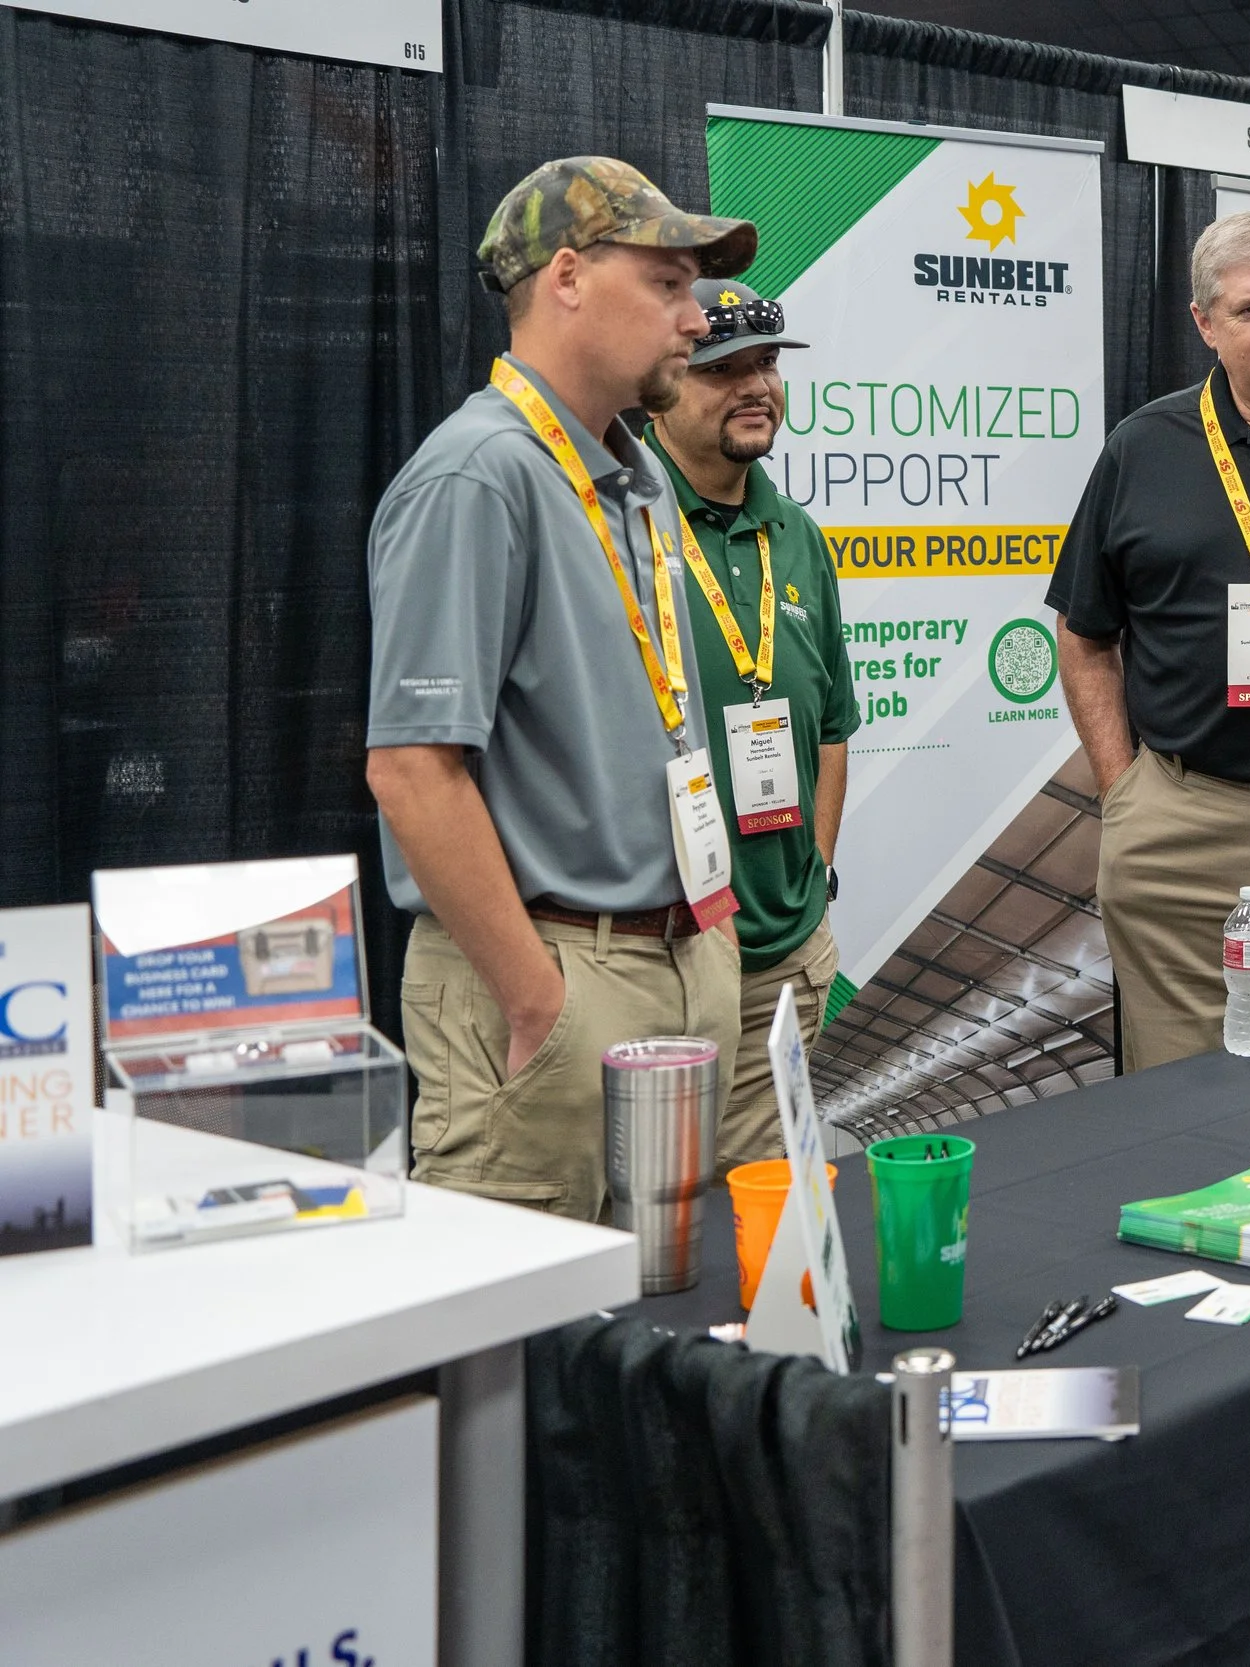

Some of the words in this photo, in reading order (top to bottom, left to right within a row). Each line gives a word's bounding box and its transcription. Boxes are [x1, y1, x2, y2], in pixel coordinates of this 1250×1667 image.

[404, 42, 426, 61] 615
[914, 253, 1069, 293] SUNBELT
[937, 289, 1047, 307] RENTALS
[784, 380, 1080, 439] USTOMIZED
[1219, 458, 1231, 473] 3S
[768, 452, 1000, 507] UPPORT
[1233, 498, 1247, 514] 3S
[829, 536, 917, 568] YOUR
[926, 534, 1060, 567] PROJECT
[842, 618, 969, 648] emporary
[853, 659, 897, 681] res
[903, 652, 942, 679] for
[866, 691, 908, 725] job
[988, 709, 1025, 723] LEARN
[1028, 708, 1059, 721] MORE
[750, 736, 773, 747] Miguel
[747, 812, 793, 828] SPONSOR
[178, 949, 215, 965] YOUR
[124, 967, 189, 987] BUSINESS
[190, 964, 229, 980] CARD
[139, 985, 172, 999] HERE
[176, 982, 203, 996] FOR
[205, 981, 217, 995] A
[121, 1000, 178, 1018] CHANCE
[181, 998, 201, 1012] TO
